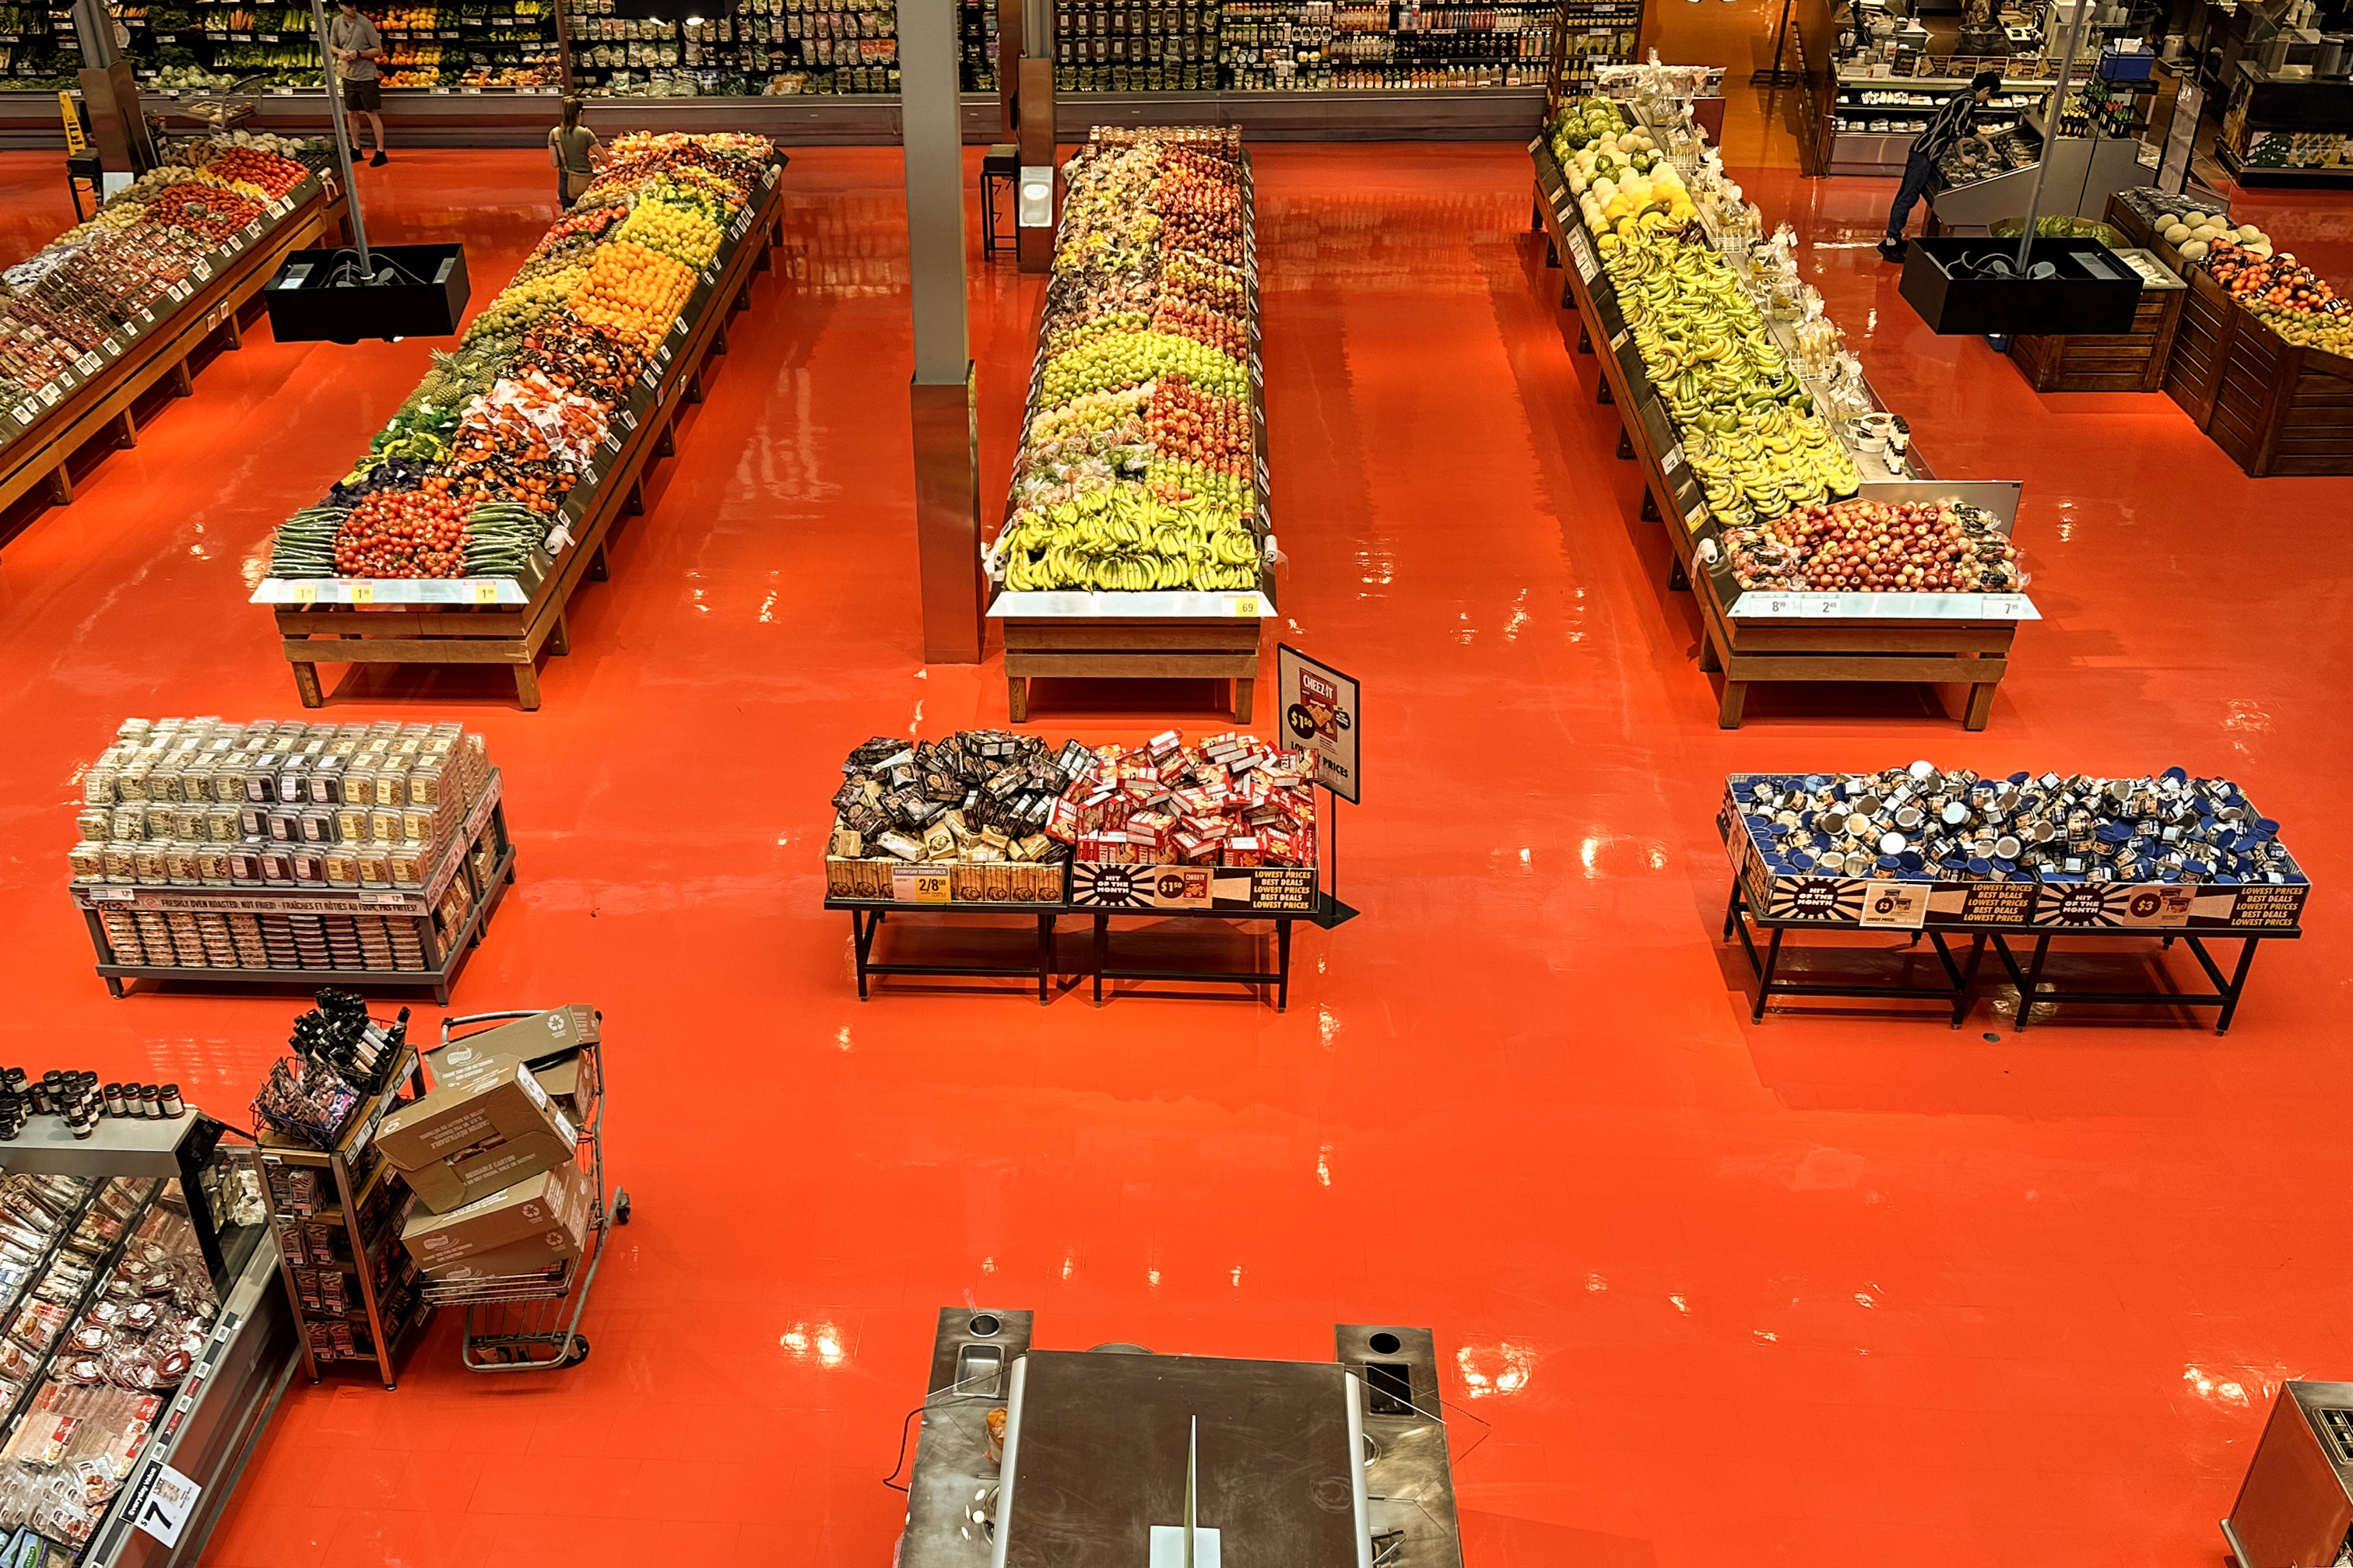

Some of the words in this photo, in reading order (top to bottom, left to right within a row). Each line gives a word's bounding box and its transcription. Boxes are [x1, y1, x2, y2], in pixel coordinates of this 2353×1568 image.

[1242, 602, 1254, 612] 69
[1322, 756, 1348, 778] PRICES
[1285, 871, 1312, 879] PRICES
[160, 899, 189, 907] FRESHLY
[190, 900, 208, 908] OVEN
[2137, 900, 2153, 912] $3
[128, 1484, 149, 1516] Everyday
[143, 1467, 156, 1486] Value
